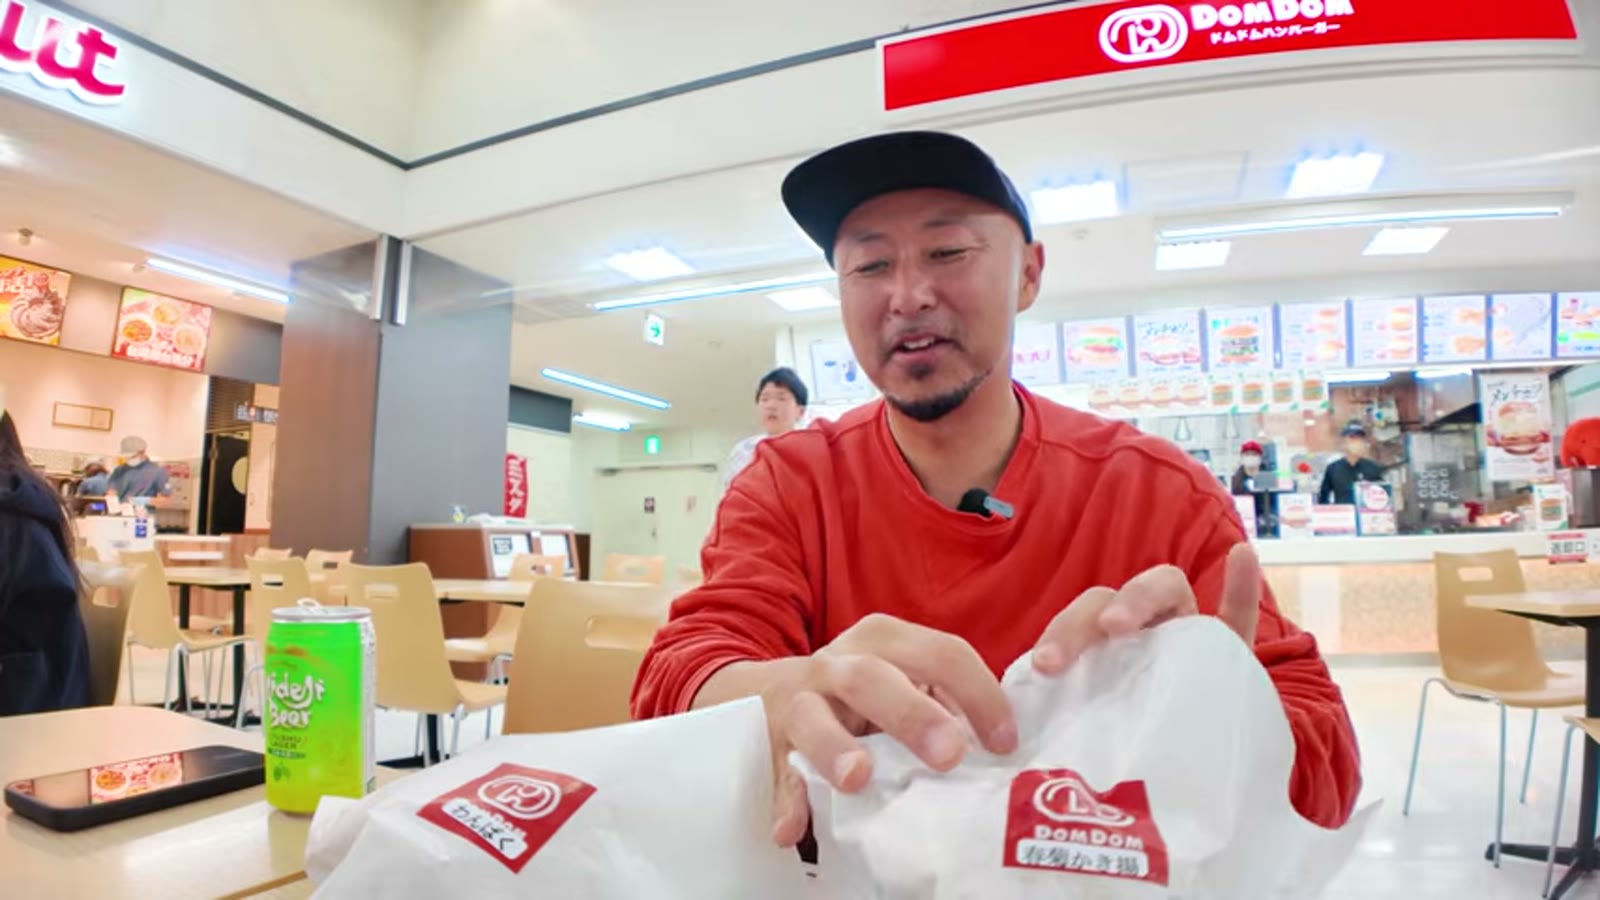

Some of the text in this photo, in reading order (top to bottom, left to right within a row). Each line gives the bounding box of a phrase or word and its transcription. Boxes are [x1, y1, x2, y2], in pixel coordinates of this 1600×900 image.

[1210, 21, 1341, 45] ドムドムハンバーガー
[1034, 825, 1143, 850] DOMDOM
